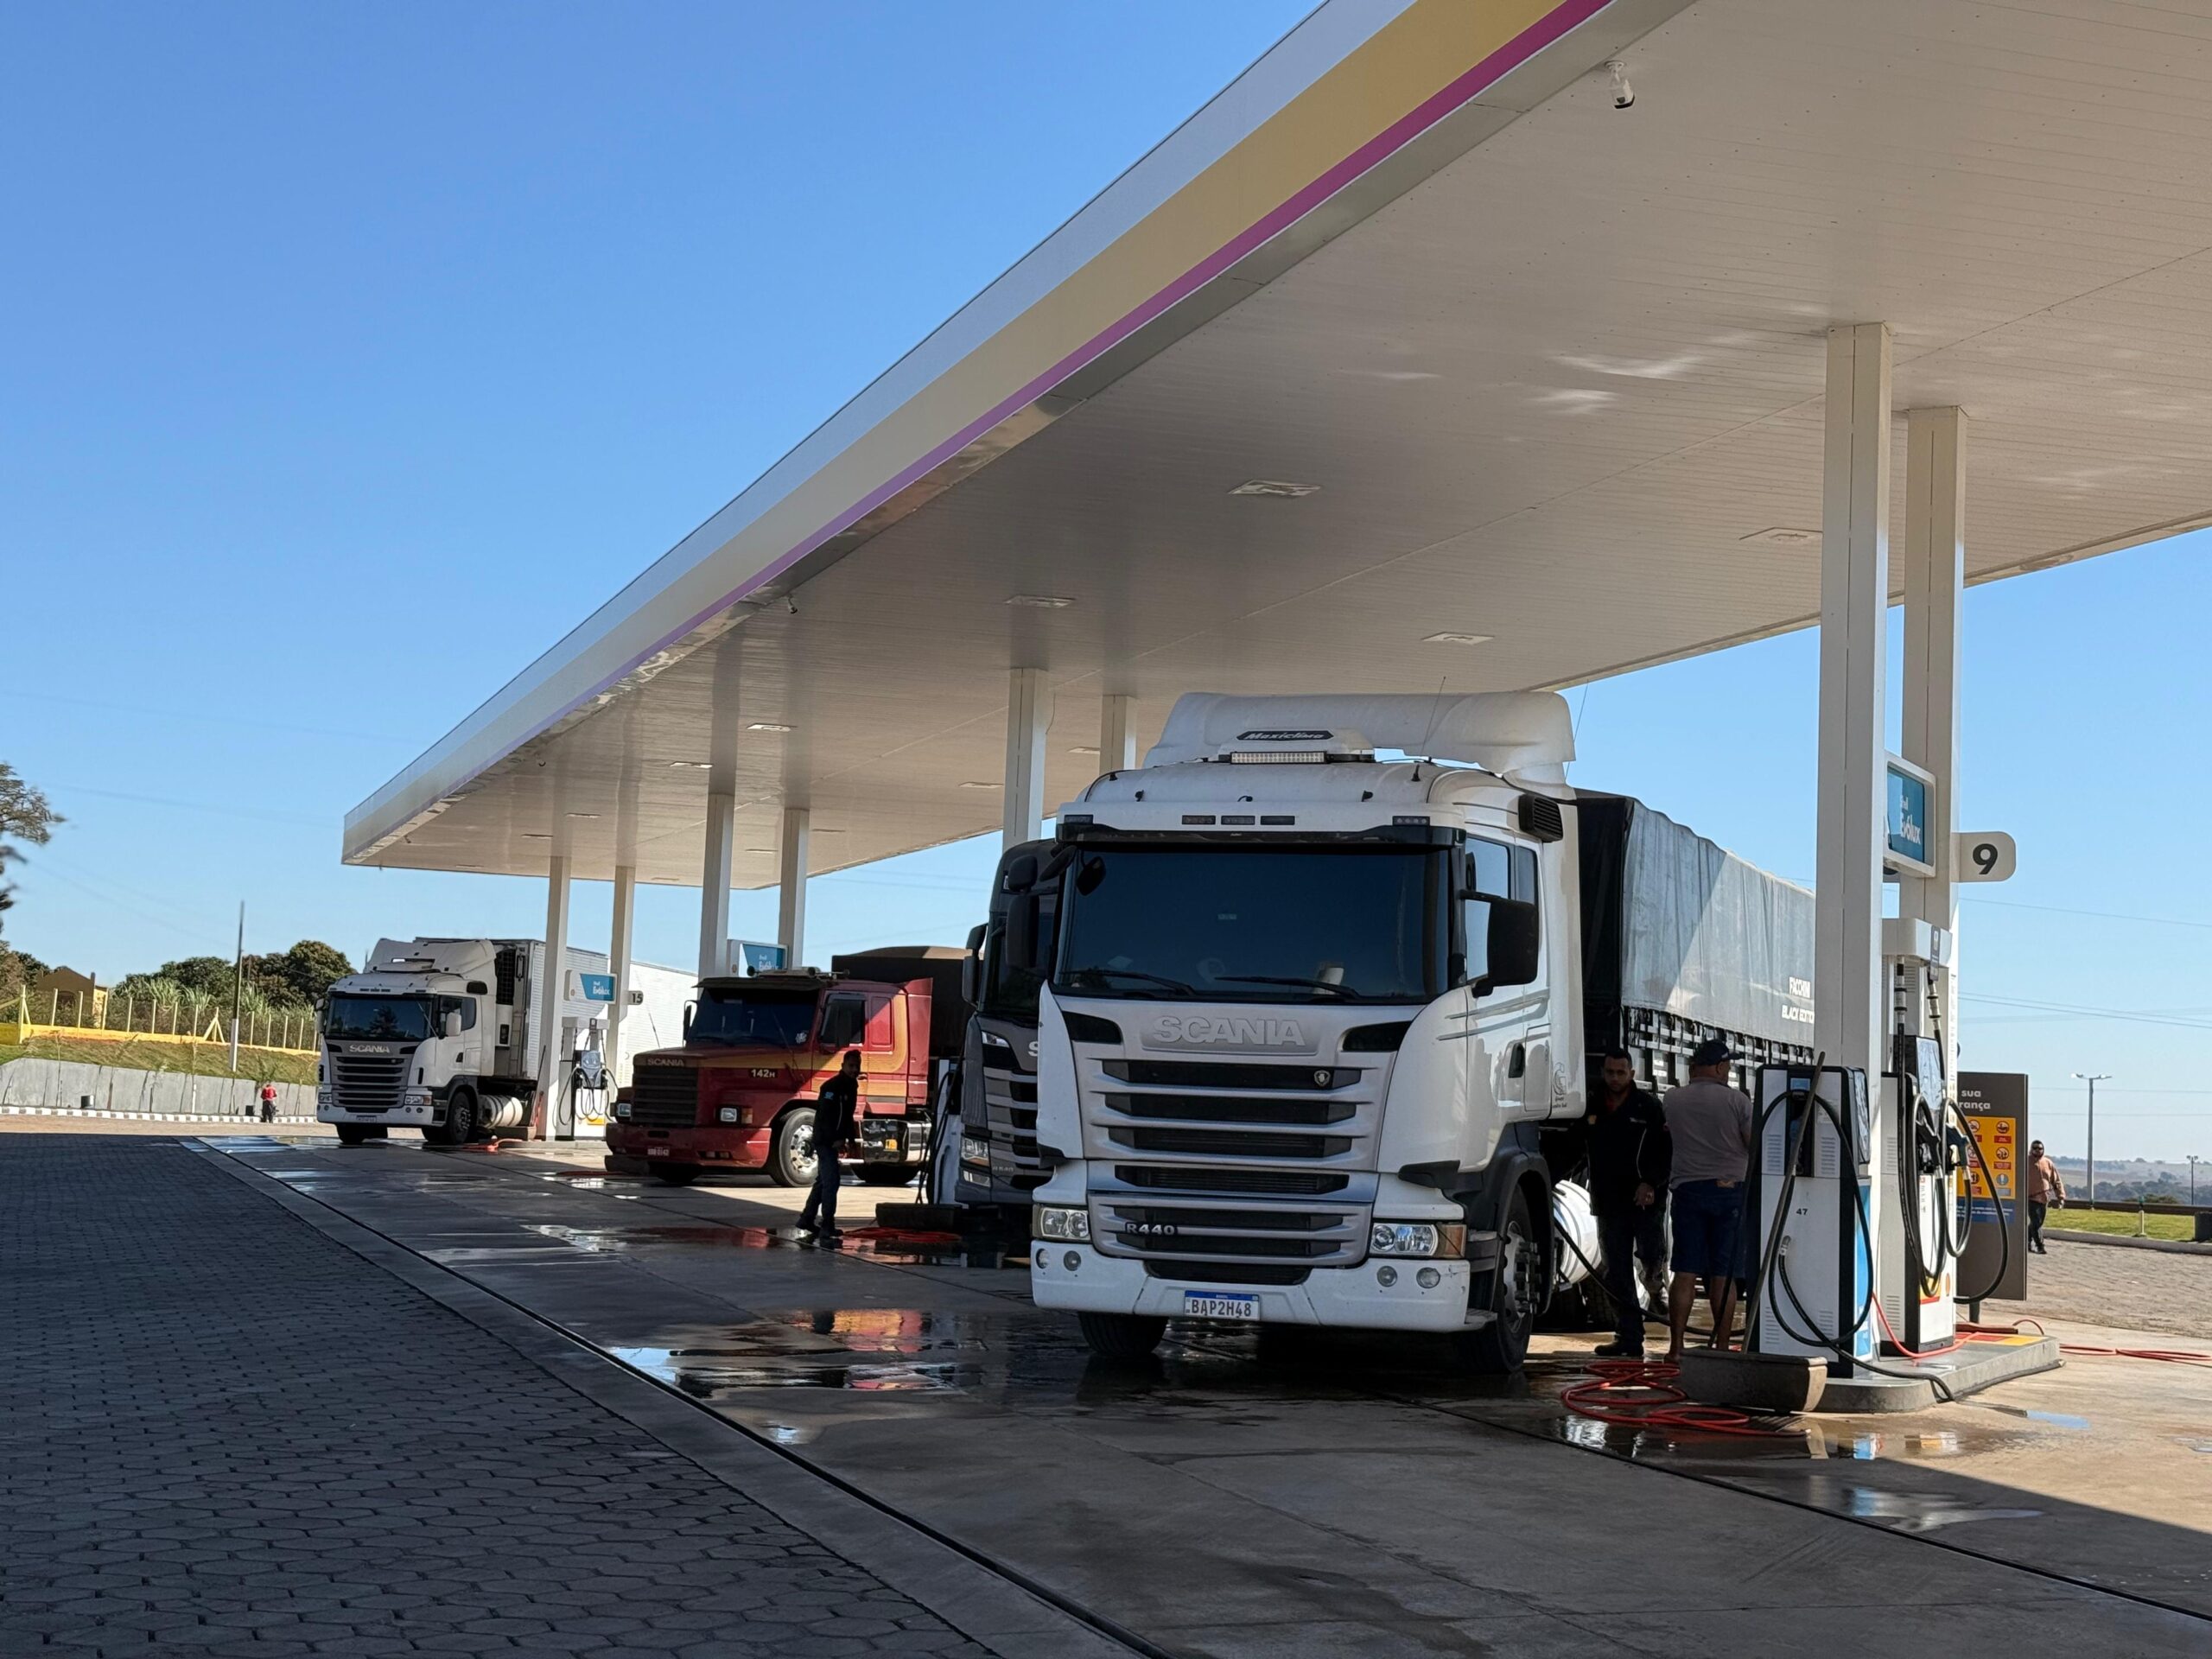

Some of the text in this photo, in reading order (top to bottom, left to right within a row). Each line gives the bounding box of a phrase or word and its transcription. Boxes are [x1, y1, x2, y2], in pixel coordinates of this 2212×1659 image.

[1973, 843, 1999, 875] 9
[632, 993, 644, 1003] 15
[1782, 1004, 1815, 1024] BLACK EDITIO
[1153, 1015, 1306, 1046] SCANIA
[349, 1044, 391, 1053] SCANIA
[648, 1058, 685, 1067] SCANIA
[1958, 1101, 1991, 1112] rança
[1126, 1223, 1175, 1236] R440
[1192, 1299, 1252, 1317] BAP2H48
